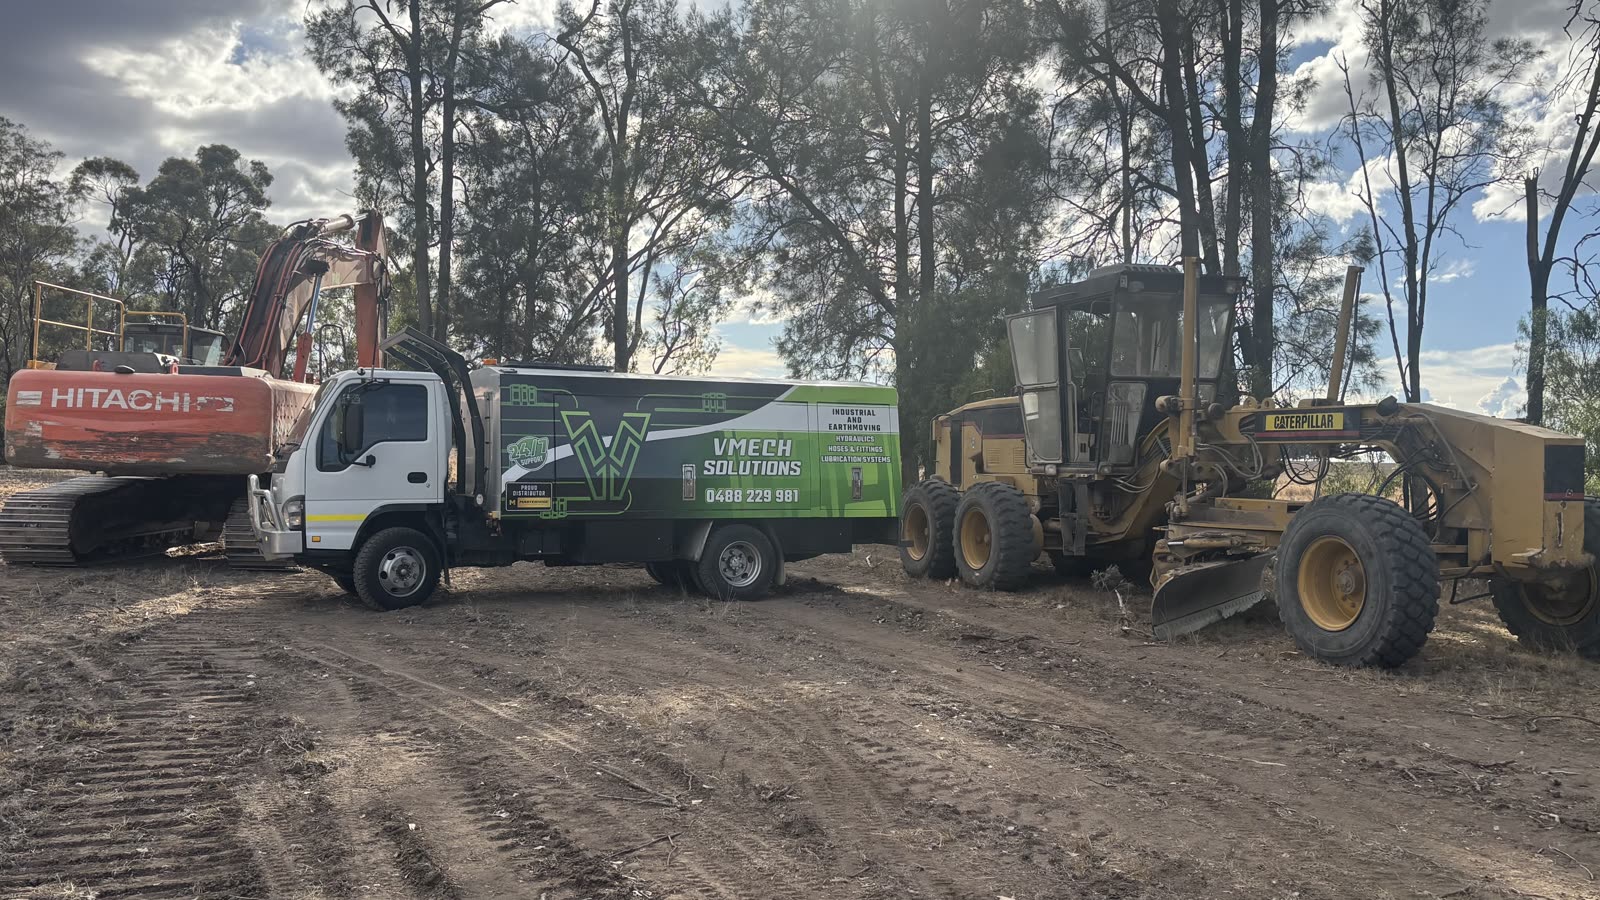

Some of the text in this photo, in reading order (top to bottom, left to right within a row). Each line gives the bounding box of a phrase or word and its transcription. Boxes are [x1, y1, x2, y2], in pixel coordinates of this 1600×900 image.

[51, 387, 190, 412] HITACHI
[832, 408, 876, 416] INDUSTRIAL
[828, 423, 881, 431] EARTHMOVING
[1274, 414, 1334, 429] CATERPILLAR
[713, 438, 792, 457] VMECH
[520, 455, 544, 466] SUPPORT
[821, 455, 862, 463] LUBRICATION
[703, 460, 801, 476] SOLUTIONS
[706, 488, 799, 503] 0488 229 981
